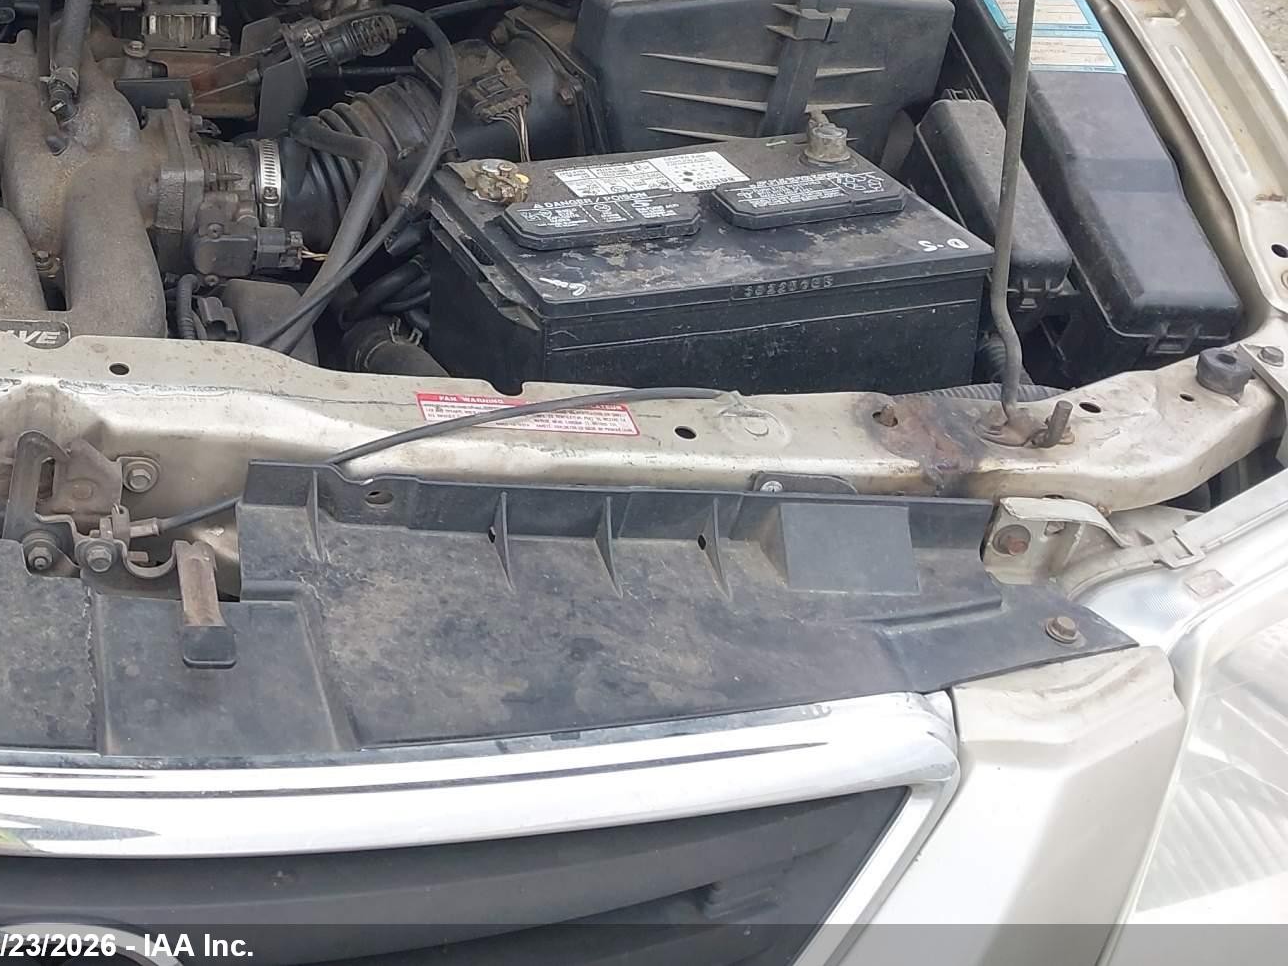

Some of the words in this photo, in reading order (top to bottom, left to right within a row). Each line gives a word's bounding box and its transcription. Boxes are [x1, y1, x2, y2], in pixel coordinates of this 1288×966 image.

[544, 198, 592, 208] DANGER
[603, 191, 649, 202] POISON
[438, 395, 457, 403] FAN
[461, 396, 505, 405] WARNING
